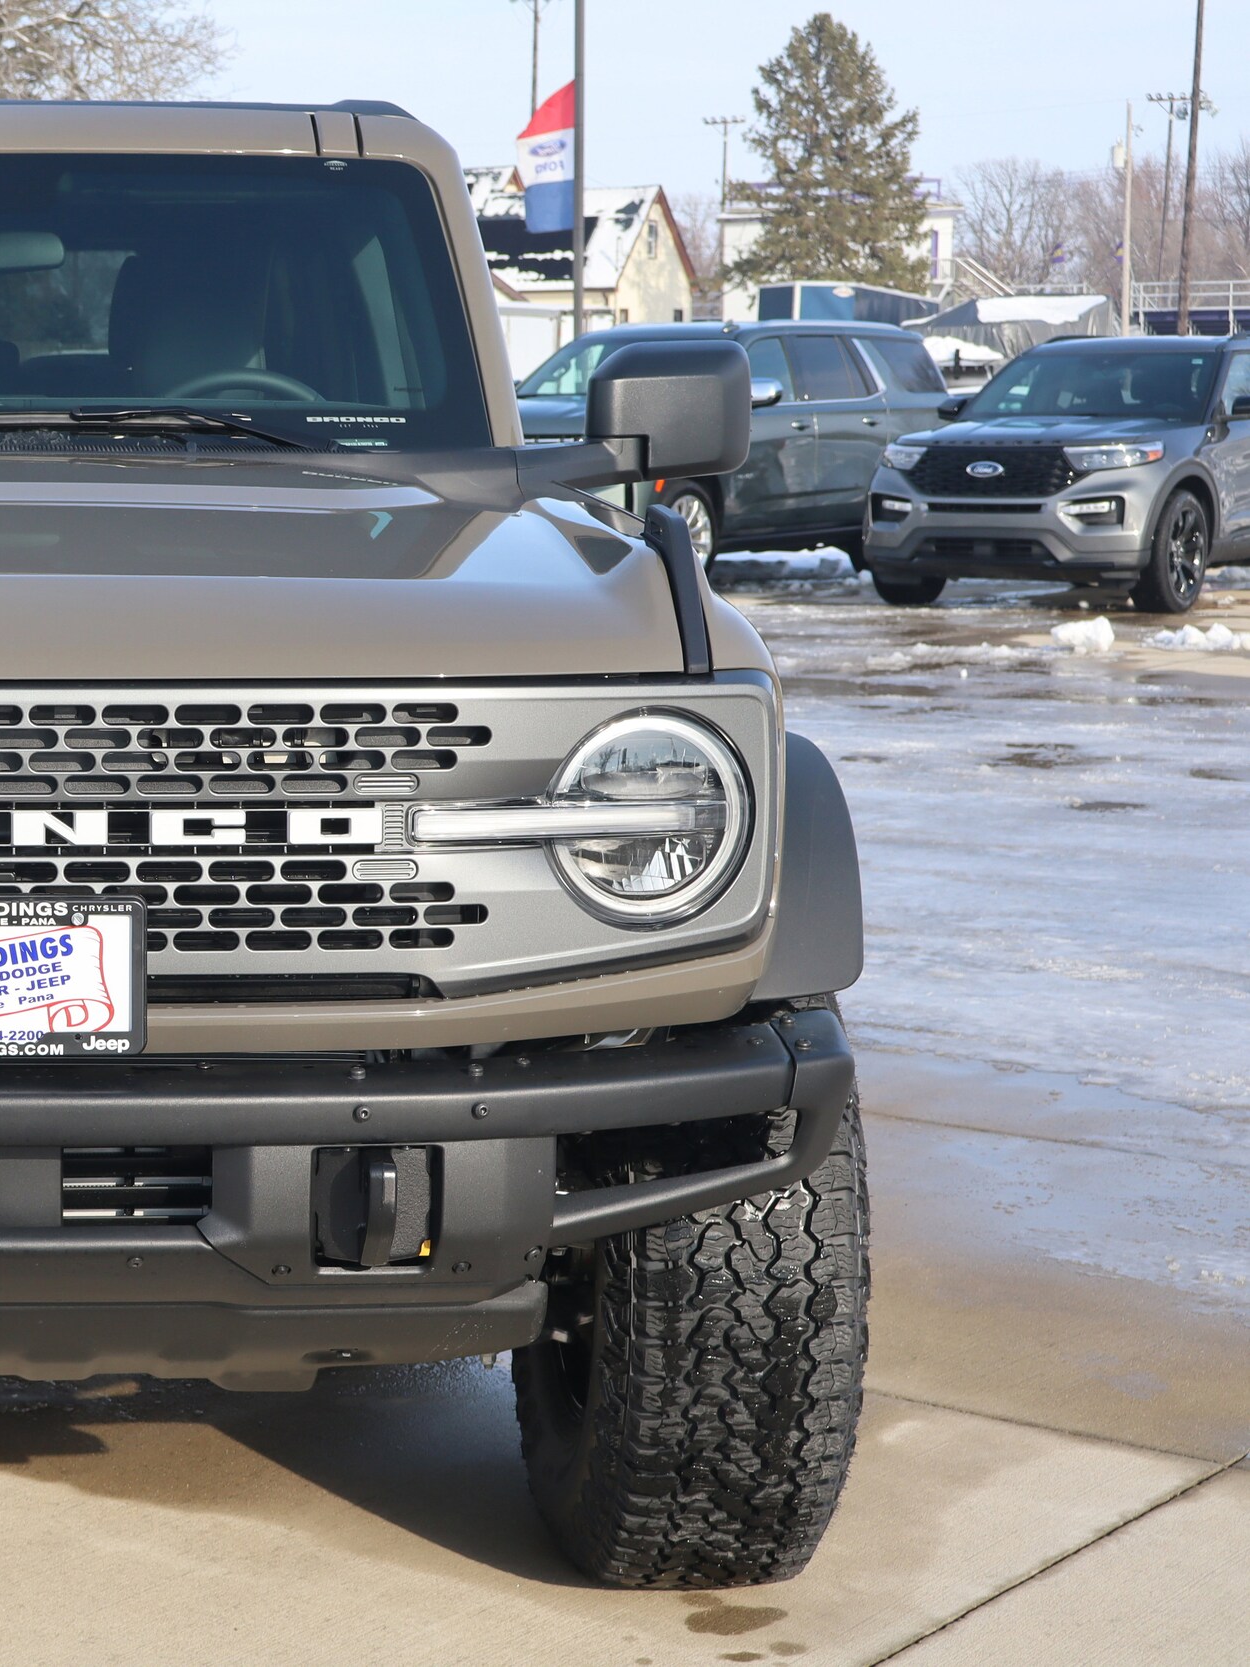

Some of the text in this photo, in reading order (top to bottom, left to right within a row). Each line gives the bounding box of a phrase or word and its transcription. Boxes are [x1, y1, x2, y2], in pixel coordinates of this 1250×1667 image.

[306, 416, 407, 424] BRONCO
[72, 904, 133, 912] CHRYSLER
[21, 917, 57, 926] PANA
[26, 974, 72, 992] JEEP
[18, 993, 55, 1005] Pana
[82, 1035, 130, 1053] Jeep
